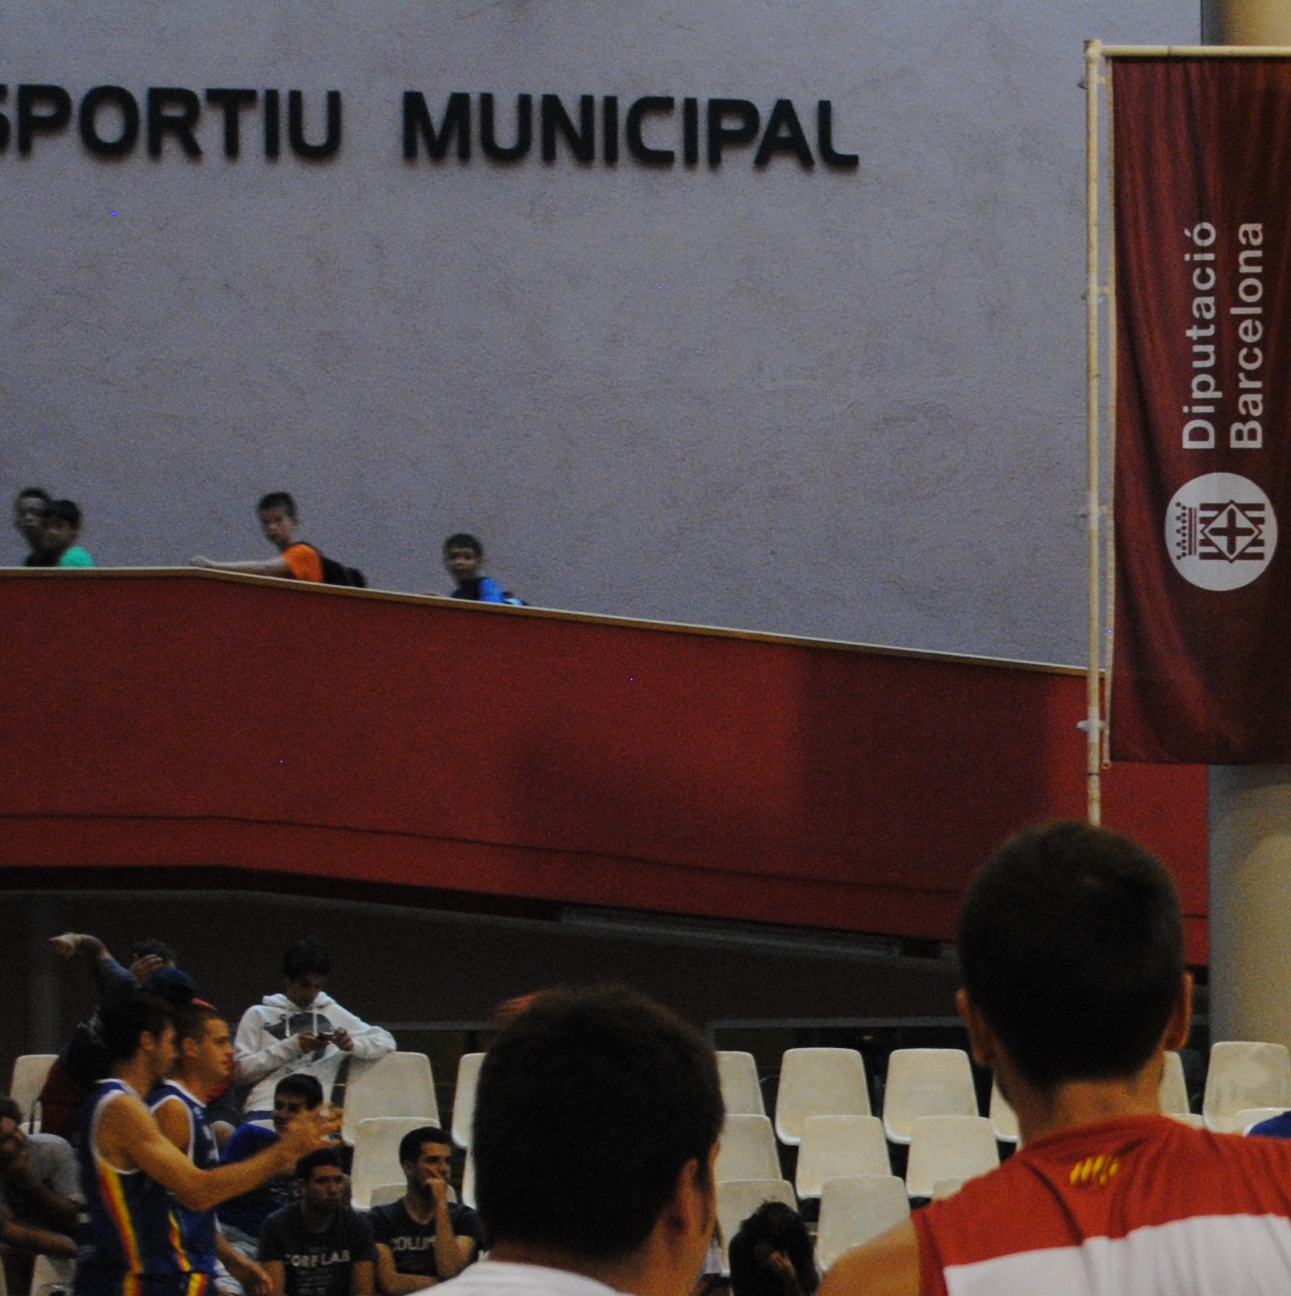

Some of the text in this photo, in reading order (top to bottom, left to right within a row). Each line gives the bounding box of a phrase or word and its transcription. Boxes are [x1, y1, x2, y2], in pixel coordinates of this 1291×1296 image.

[0, 84, 860, 169] PORTIU MUNICIPAL
[1182, 220, 1222, 449] Diputació
[1229, 222, 1264, 449] Barcelona
